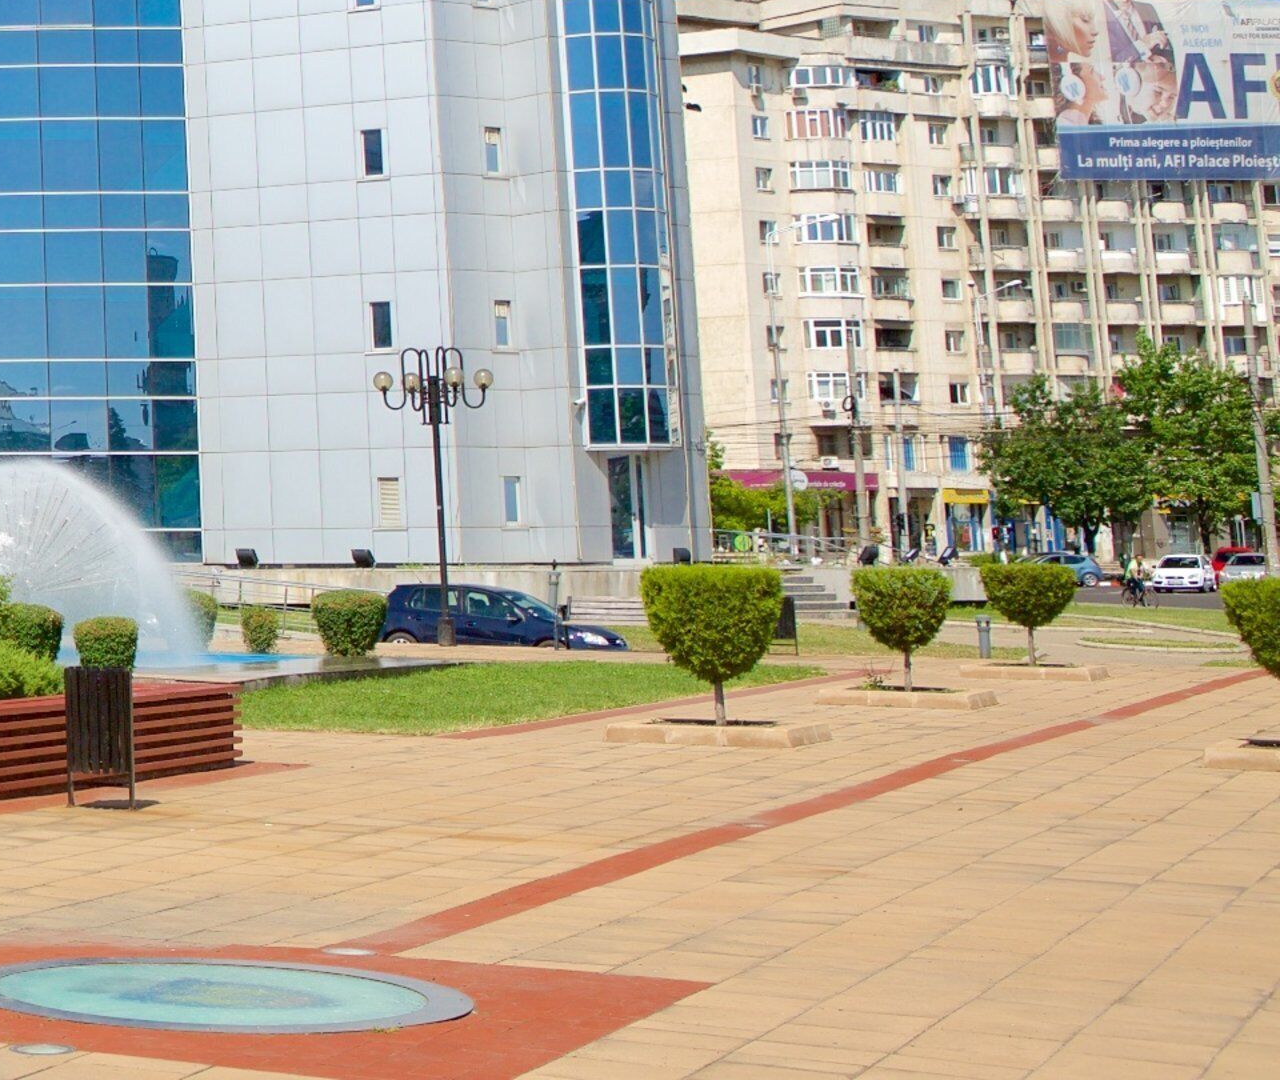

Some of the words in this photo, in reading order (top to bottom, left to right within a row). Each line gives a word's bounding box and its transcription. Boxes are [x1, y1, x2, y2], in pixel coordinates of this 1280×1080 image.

[1175, 53, 1280, 119] AF
[1108, 136, 1140, 148] Prima
[1142, 136, 1180, 150] alegere
[1182, 139, 1189, 148] a
[1077, 154, 1093, 167] La
[1136, 154, 1161, 169] ani,
[1164, 154, 1186, 167] AFI
[1189, 154, 1230, 167] Palace
[1233, 154, 1280, 171] Ploieșt
